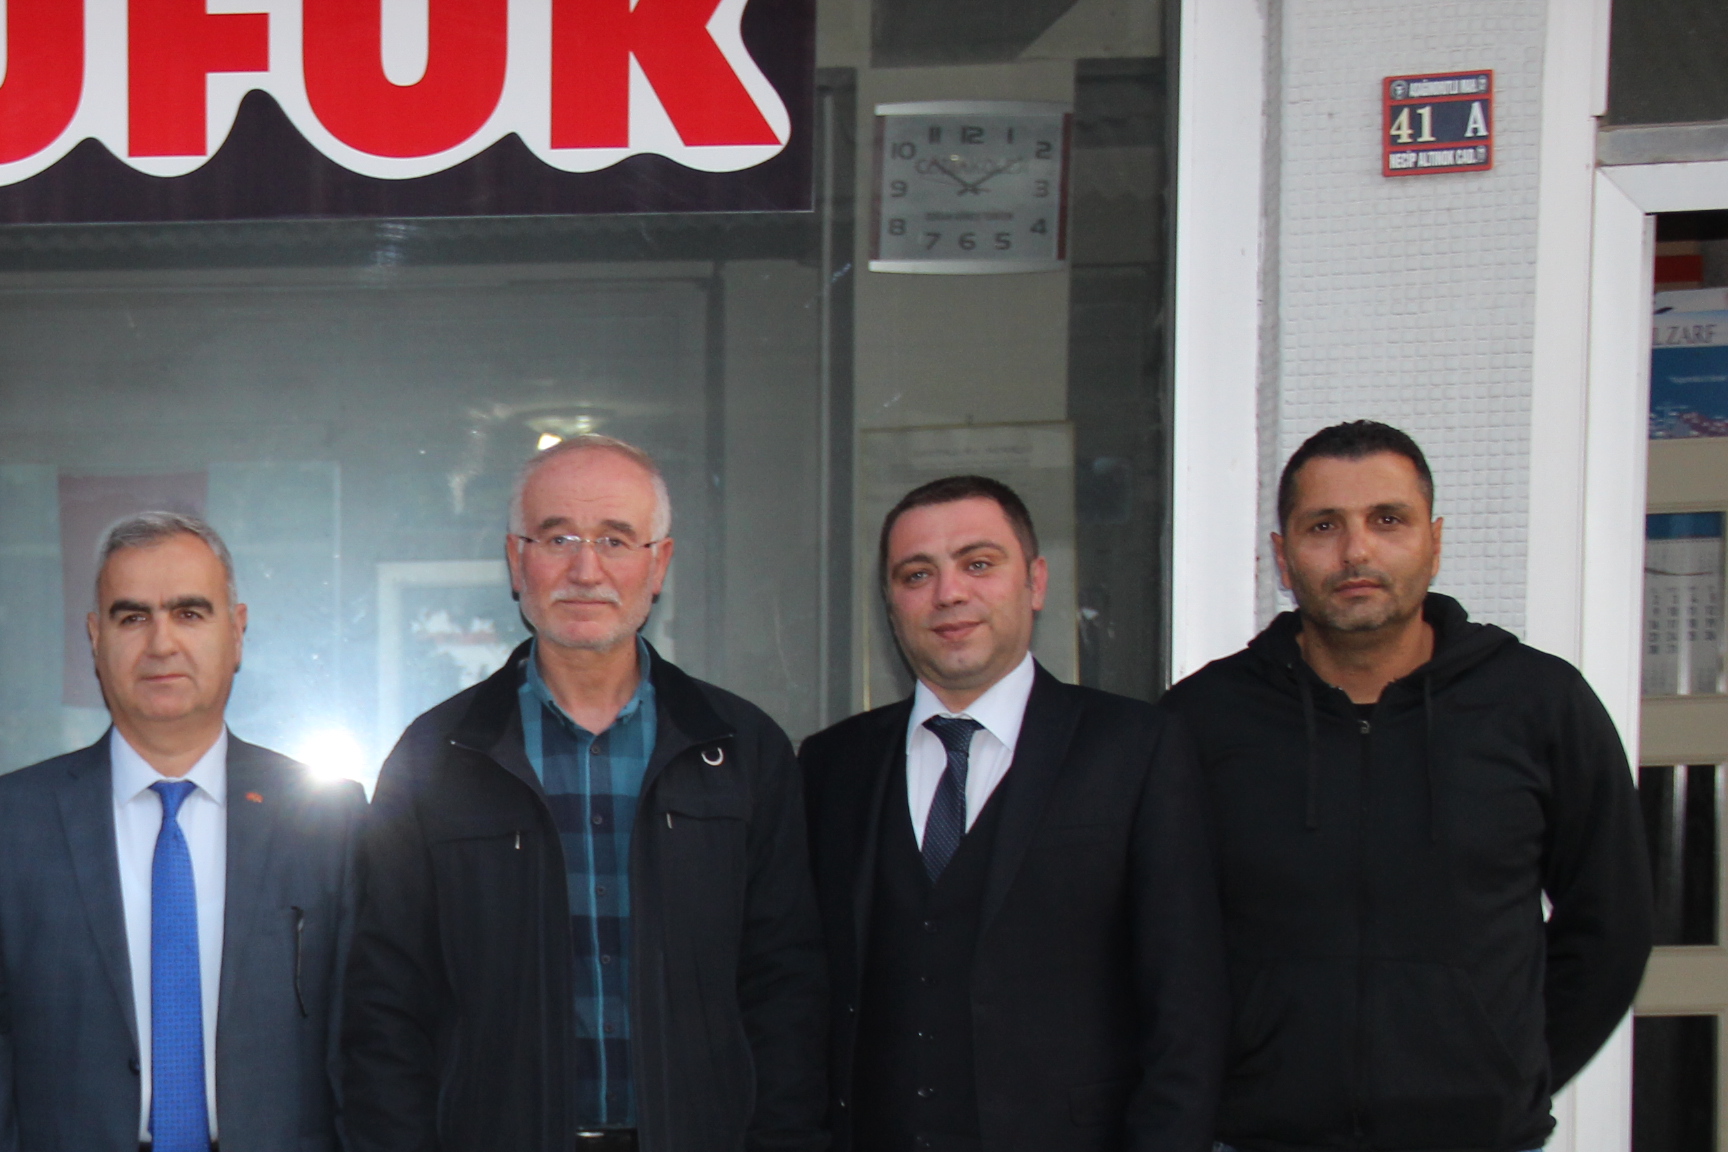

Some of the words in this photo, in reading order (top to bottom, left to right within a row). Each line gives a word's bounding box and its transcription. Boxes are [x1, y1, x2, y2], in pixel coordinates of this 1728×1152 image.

[1389, 105, 1437, 144] 41
[1464, 101, 1489, 138] A
[928, 126, 942, 144] 11
[960, 126, 984, 144] 12
[891, 141, 916, 160] 10
[1034, 141, 1052, 160] 2
[890, 179, 908, 198] 9
[1034, 179, 1049, 198] 3
[889, 218, 906, 236] 8
[1030, 217, 1047, 235] 4
[925, 232, 941, 250] 7
[958, 232, 976, 250] 6
[995, 232, 1011, 250] 5
